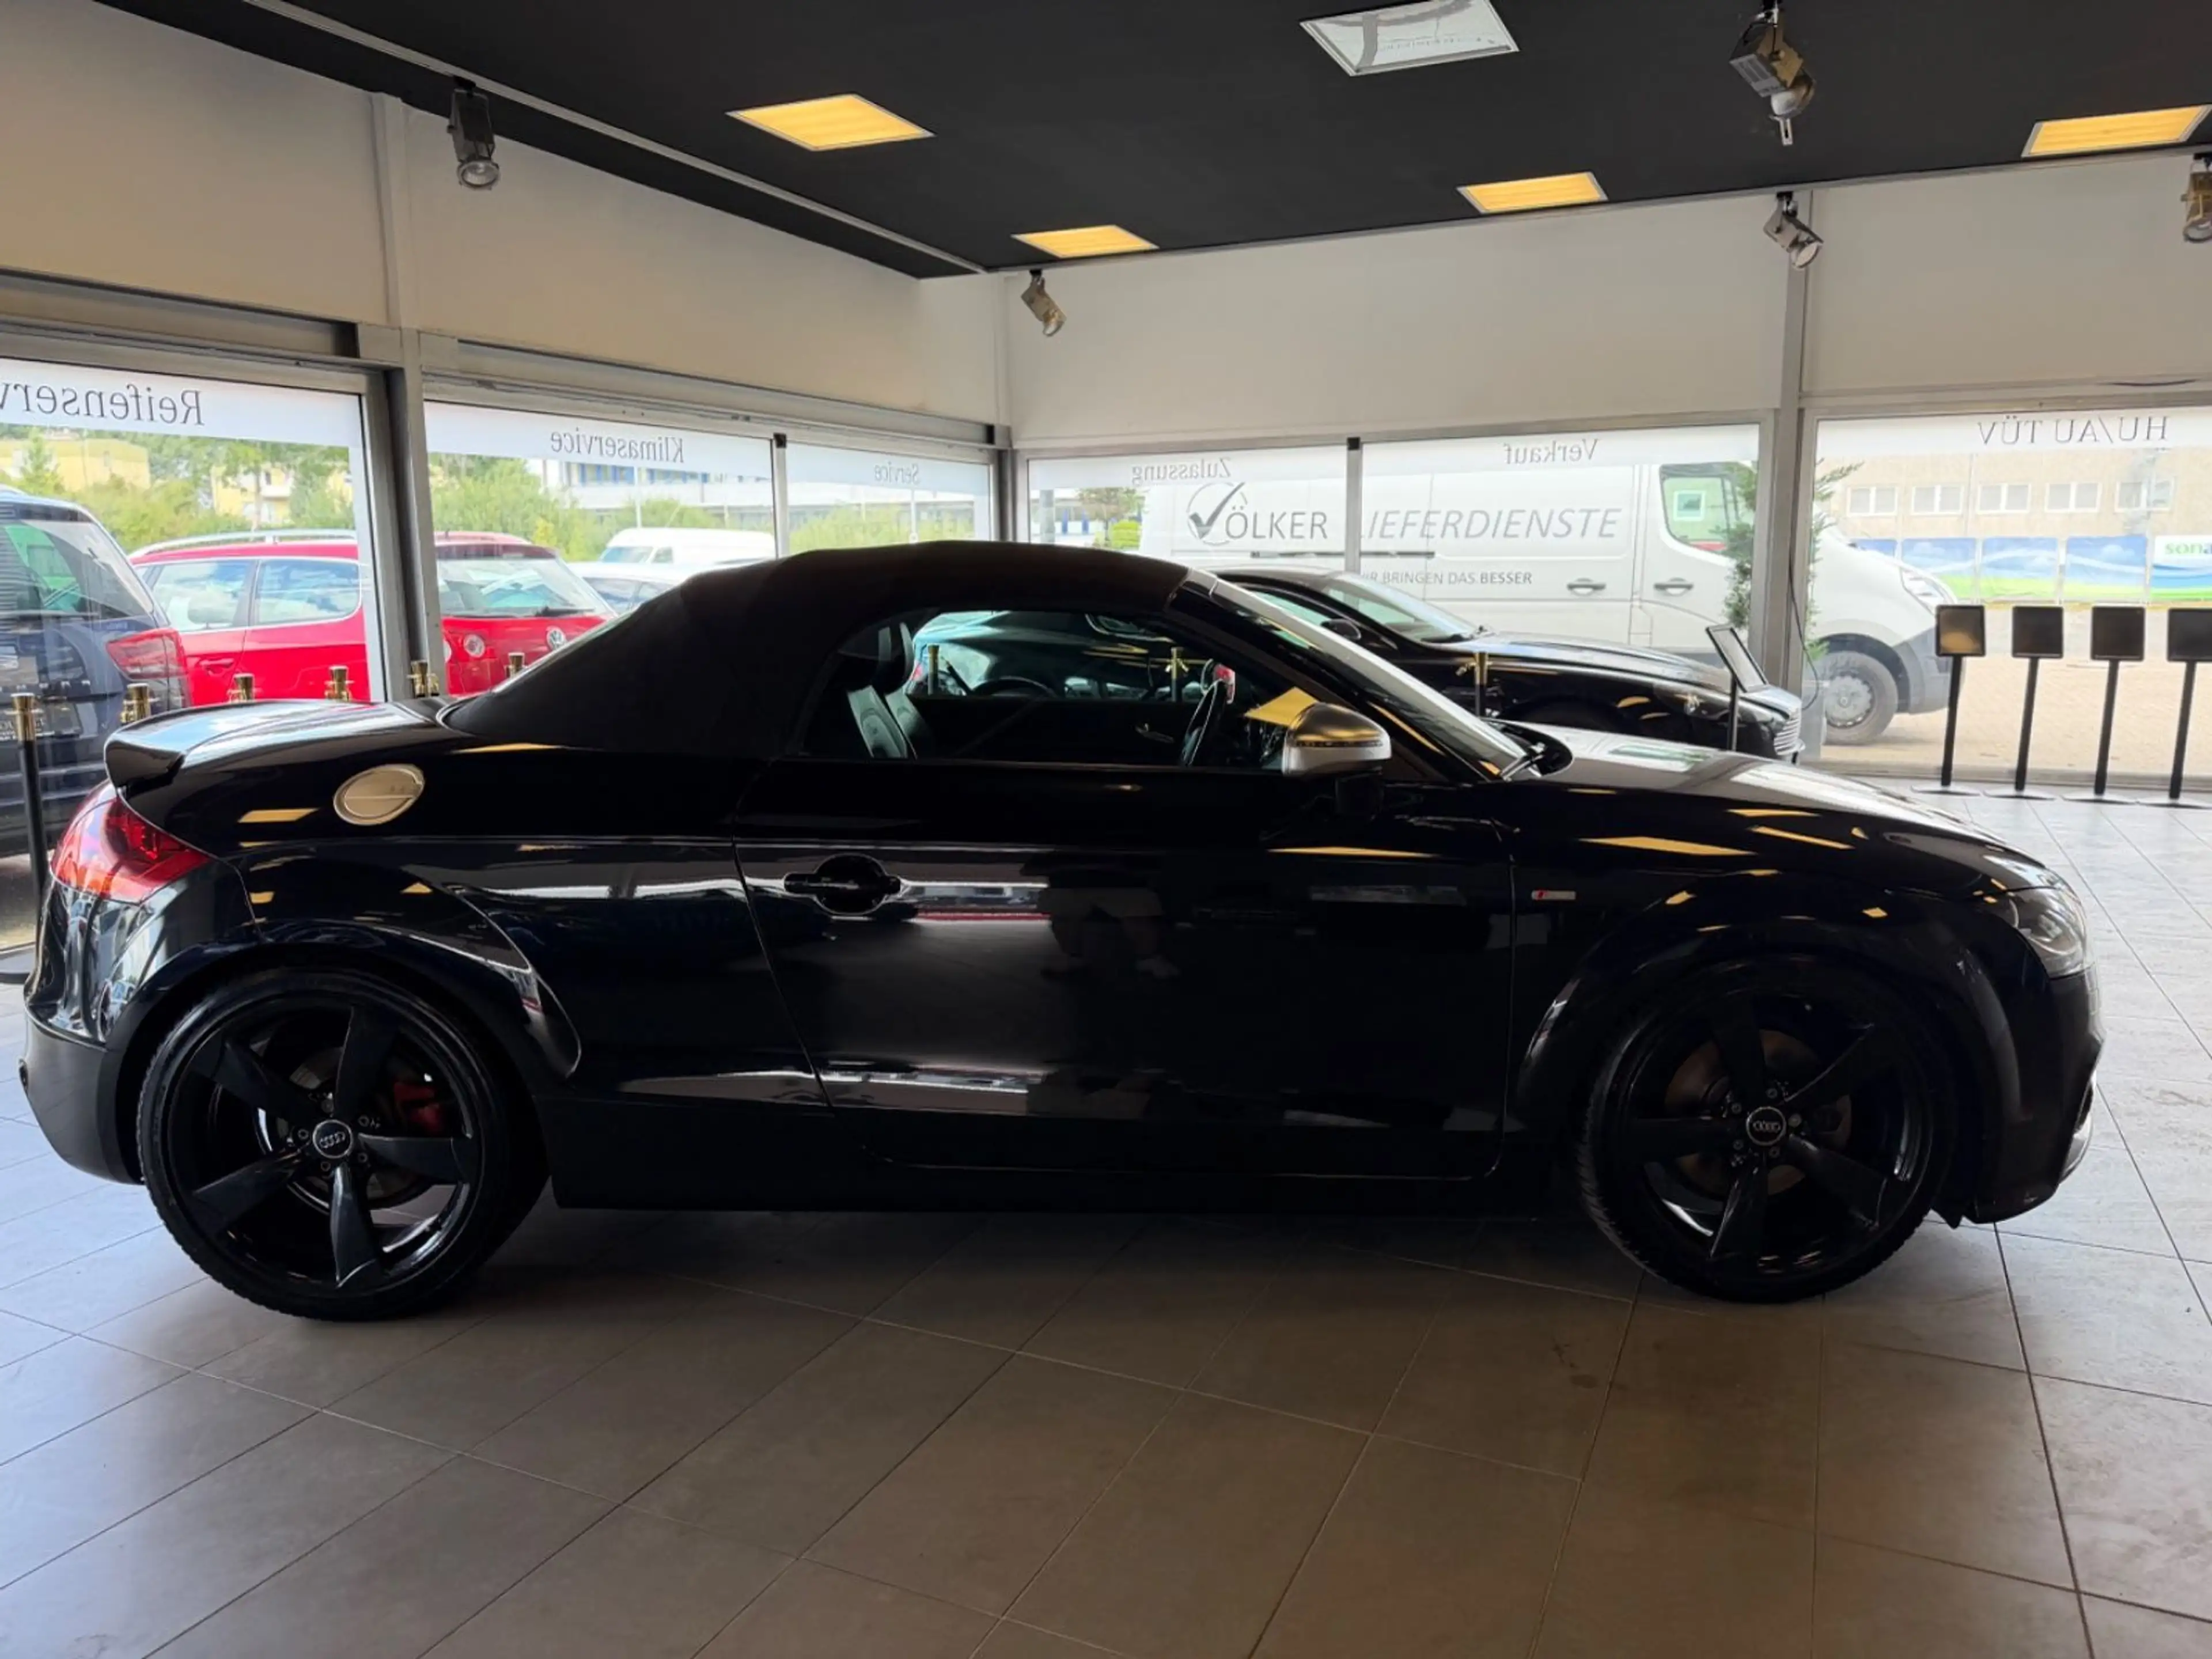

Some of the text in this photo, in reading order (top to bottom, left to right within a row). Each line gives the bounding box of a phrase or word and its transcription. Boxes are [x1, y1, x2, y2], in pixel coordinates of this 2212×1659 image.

[1361, 509, 1622, 539] IEFERDIENSTE
[1382, 571, 1443, 584] BRINGEN
[1448, 571, 1475, 584] DAS
[1479, 571, 1533, 584] BESSER
